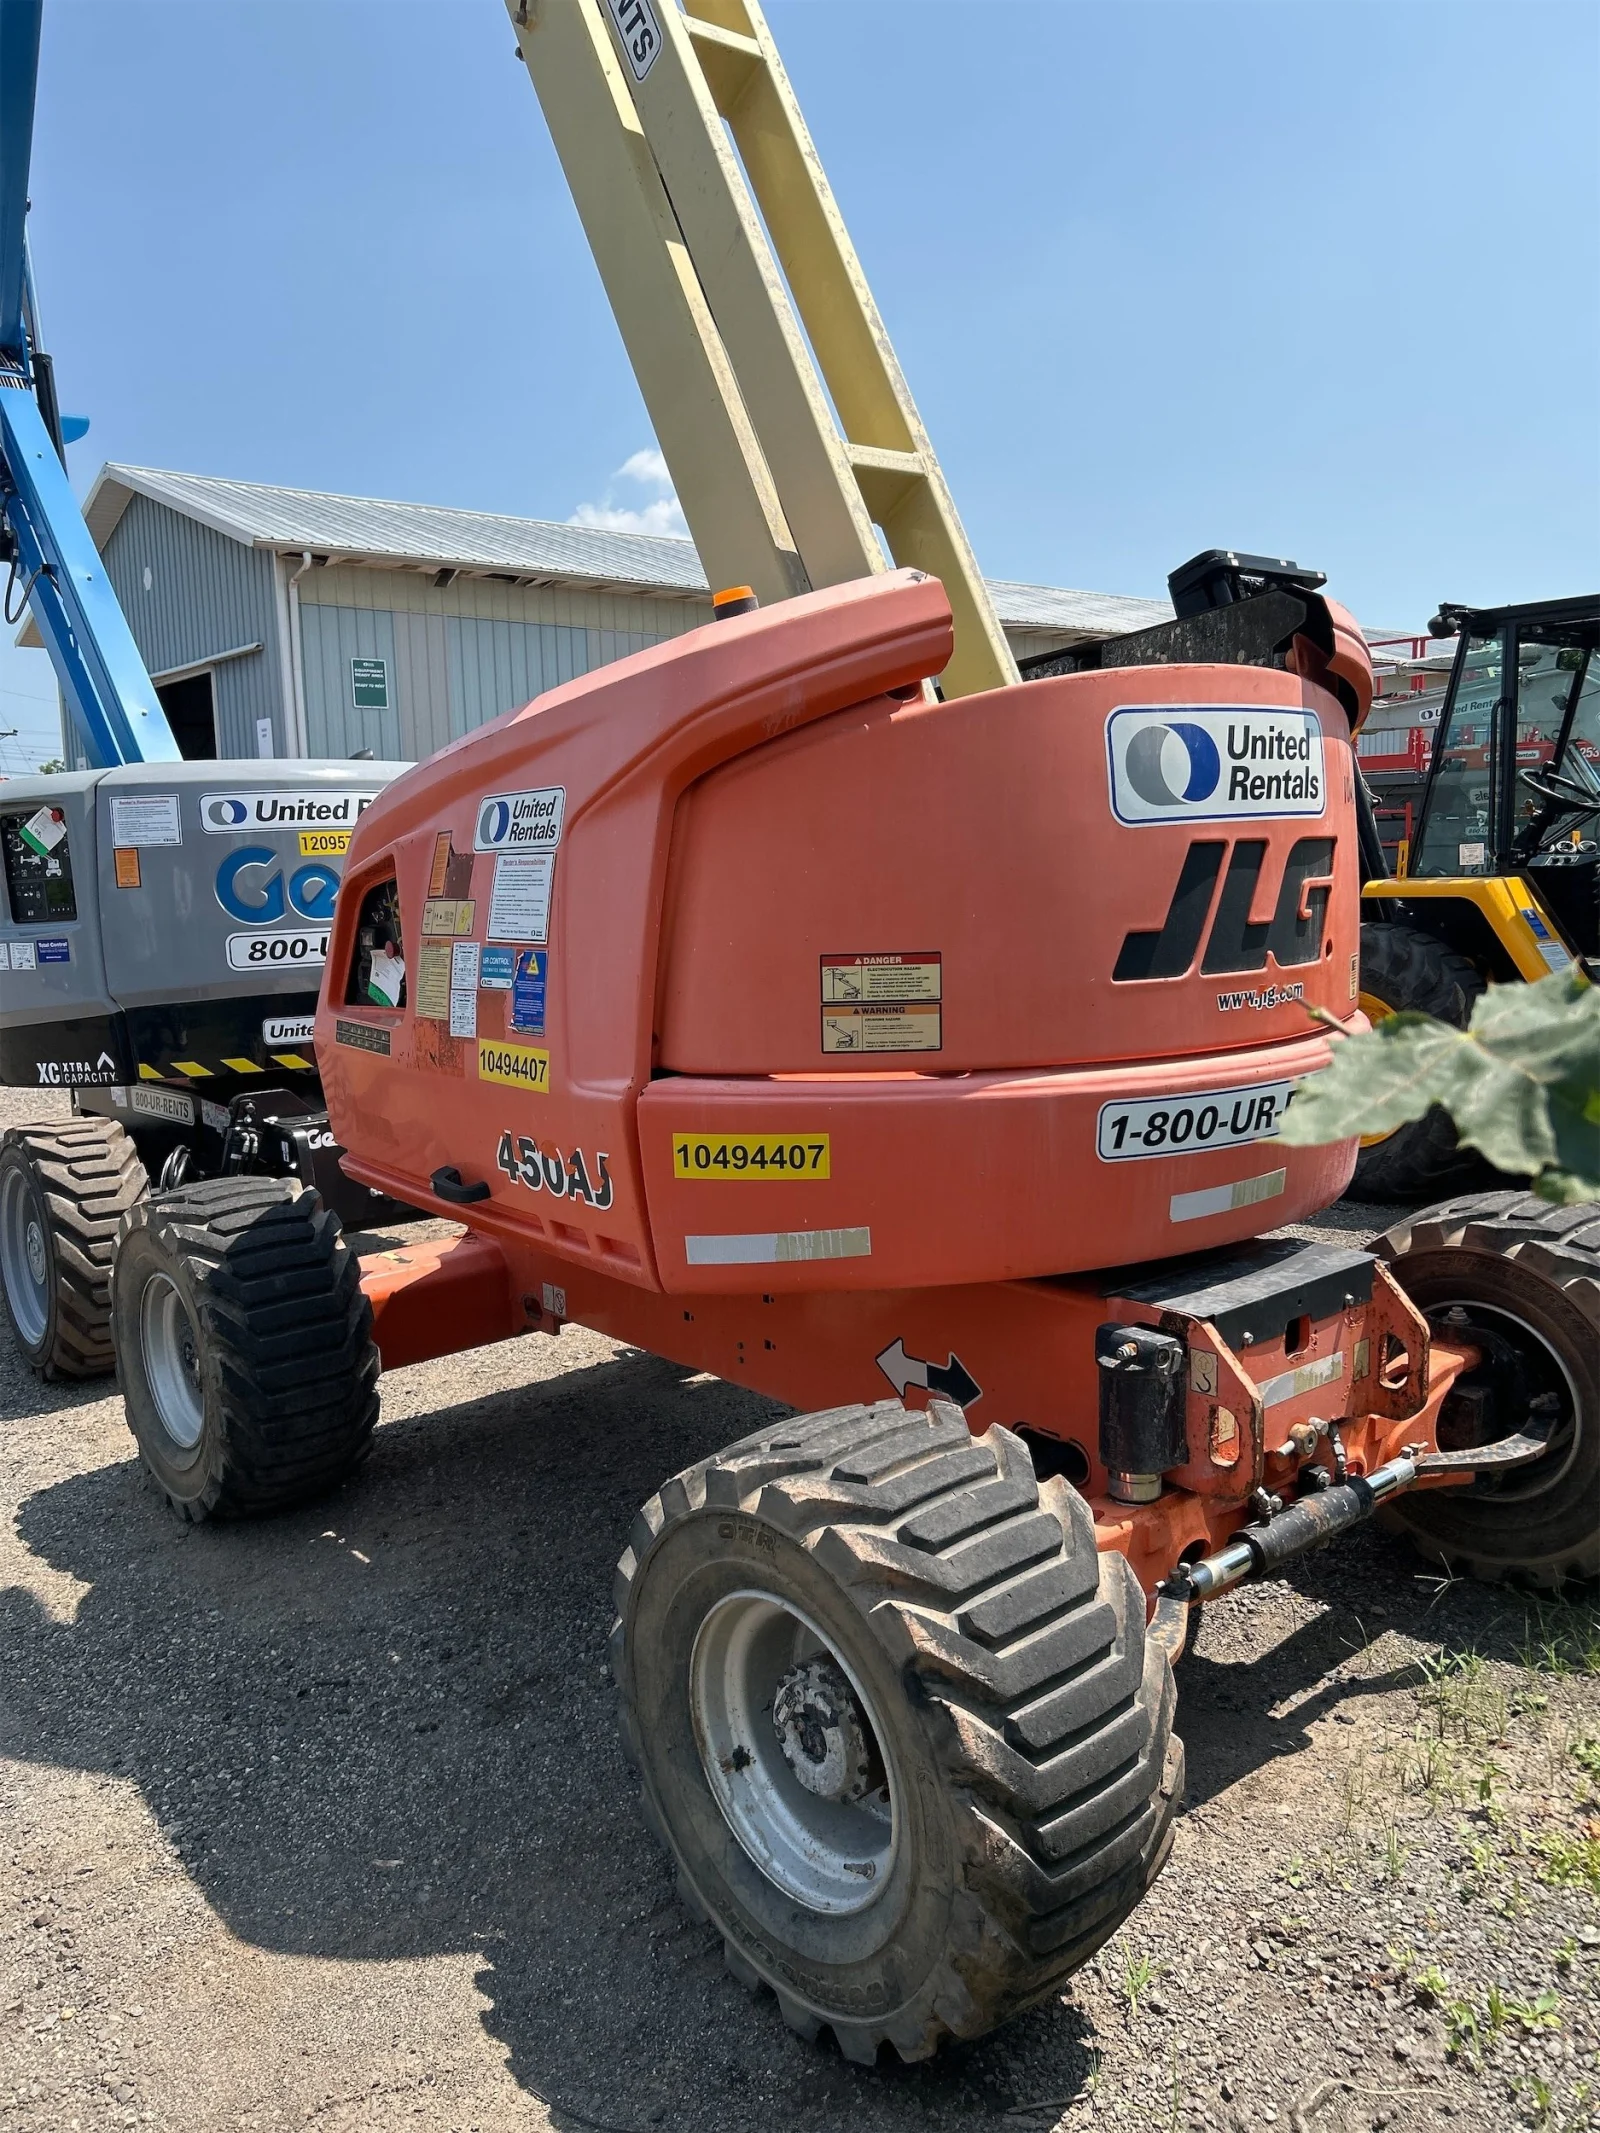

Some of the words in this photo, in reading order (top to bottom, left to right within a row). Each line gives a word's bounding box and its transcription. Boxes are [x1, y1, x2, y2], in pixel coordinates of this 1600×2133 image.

[1227, 725, 1310, 761] United
[1228, 765, 1319, 801] Rentals
[256, 799, 349, 822] United
[512, 796, 557, 819] United
[509, 819, 557, 842] Rentals
[1111, 839, 1336, 982] JLG
[490, 957, 509, 965] CONTROL
[863, 956, 902, 965] DANGER
[862, 1006, 905, 1015] WARNING
[36, 1062, 60, 1084] XC
[62, 1062, 91, 1073] XTRA
[480, 1048, 547, 1083] 10494407
[64, 1072, 116, 1084] CAPACITY
[135, 1089, 189, 1119] 800-UR-RENTS
[677, 1144, 825, 1170] 10494407
[497, 1129, 613, 1210] 450AJ
